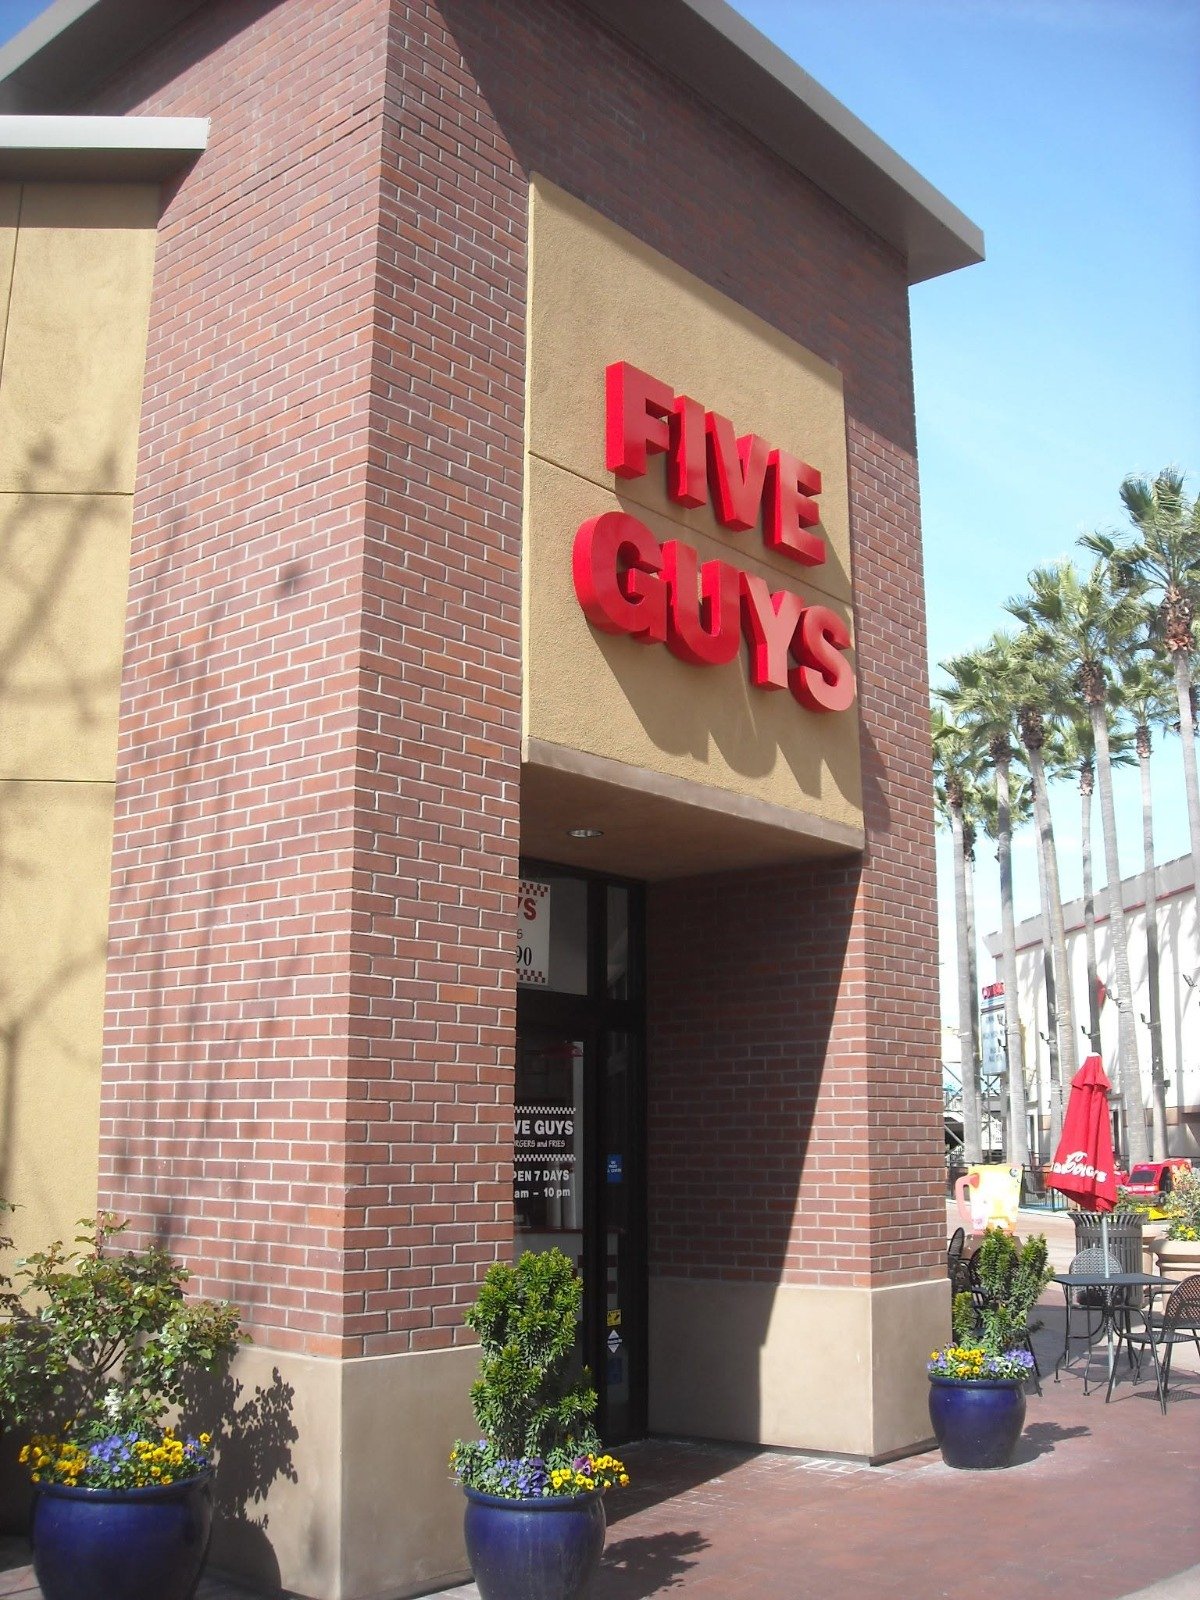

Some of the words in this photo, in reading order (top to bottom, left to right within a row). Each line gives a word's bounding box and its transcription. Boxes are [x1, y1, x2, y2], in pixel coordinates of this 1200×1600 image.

[606, 361, 826, 567] FIVE
[573, 511, 855, 712] GUYS
[534, 1120, 574, 1135] GUYS
[534, 1171, 540, 1180] 7
[543, 1170, 569, 1181] DAYS
[514, 1190, 529, 1198] am
[544, 1187, 554, 1197] 10
[556, 1189, 570, 1198] pm
